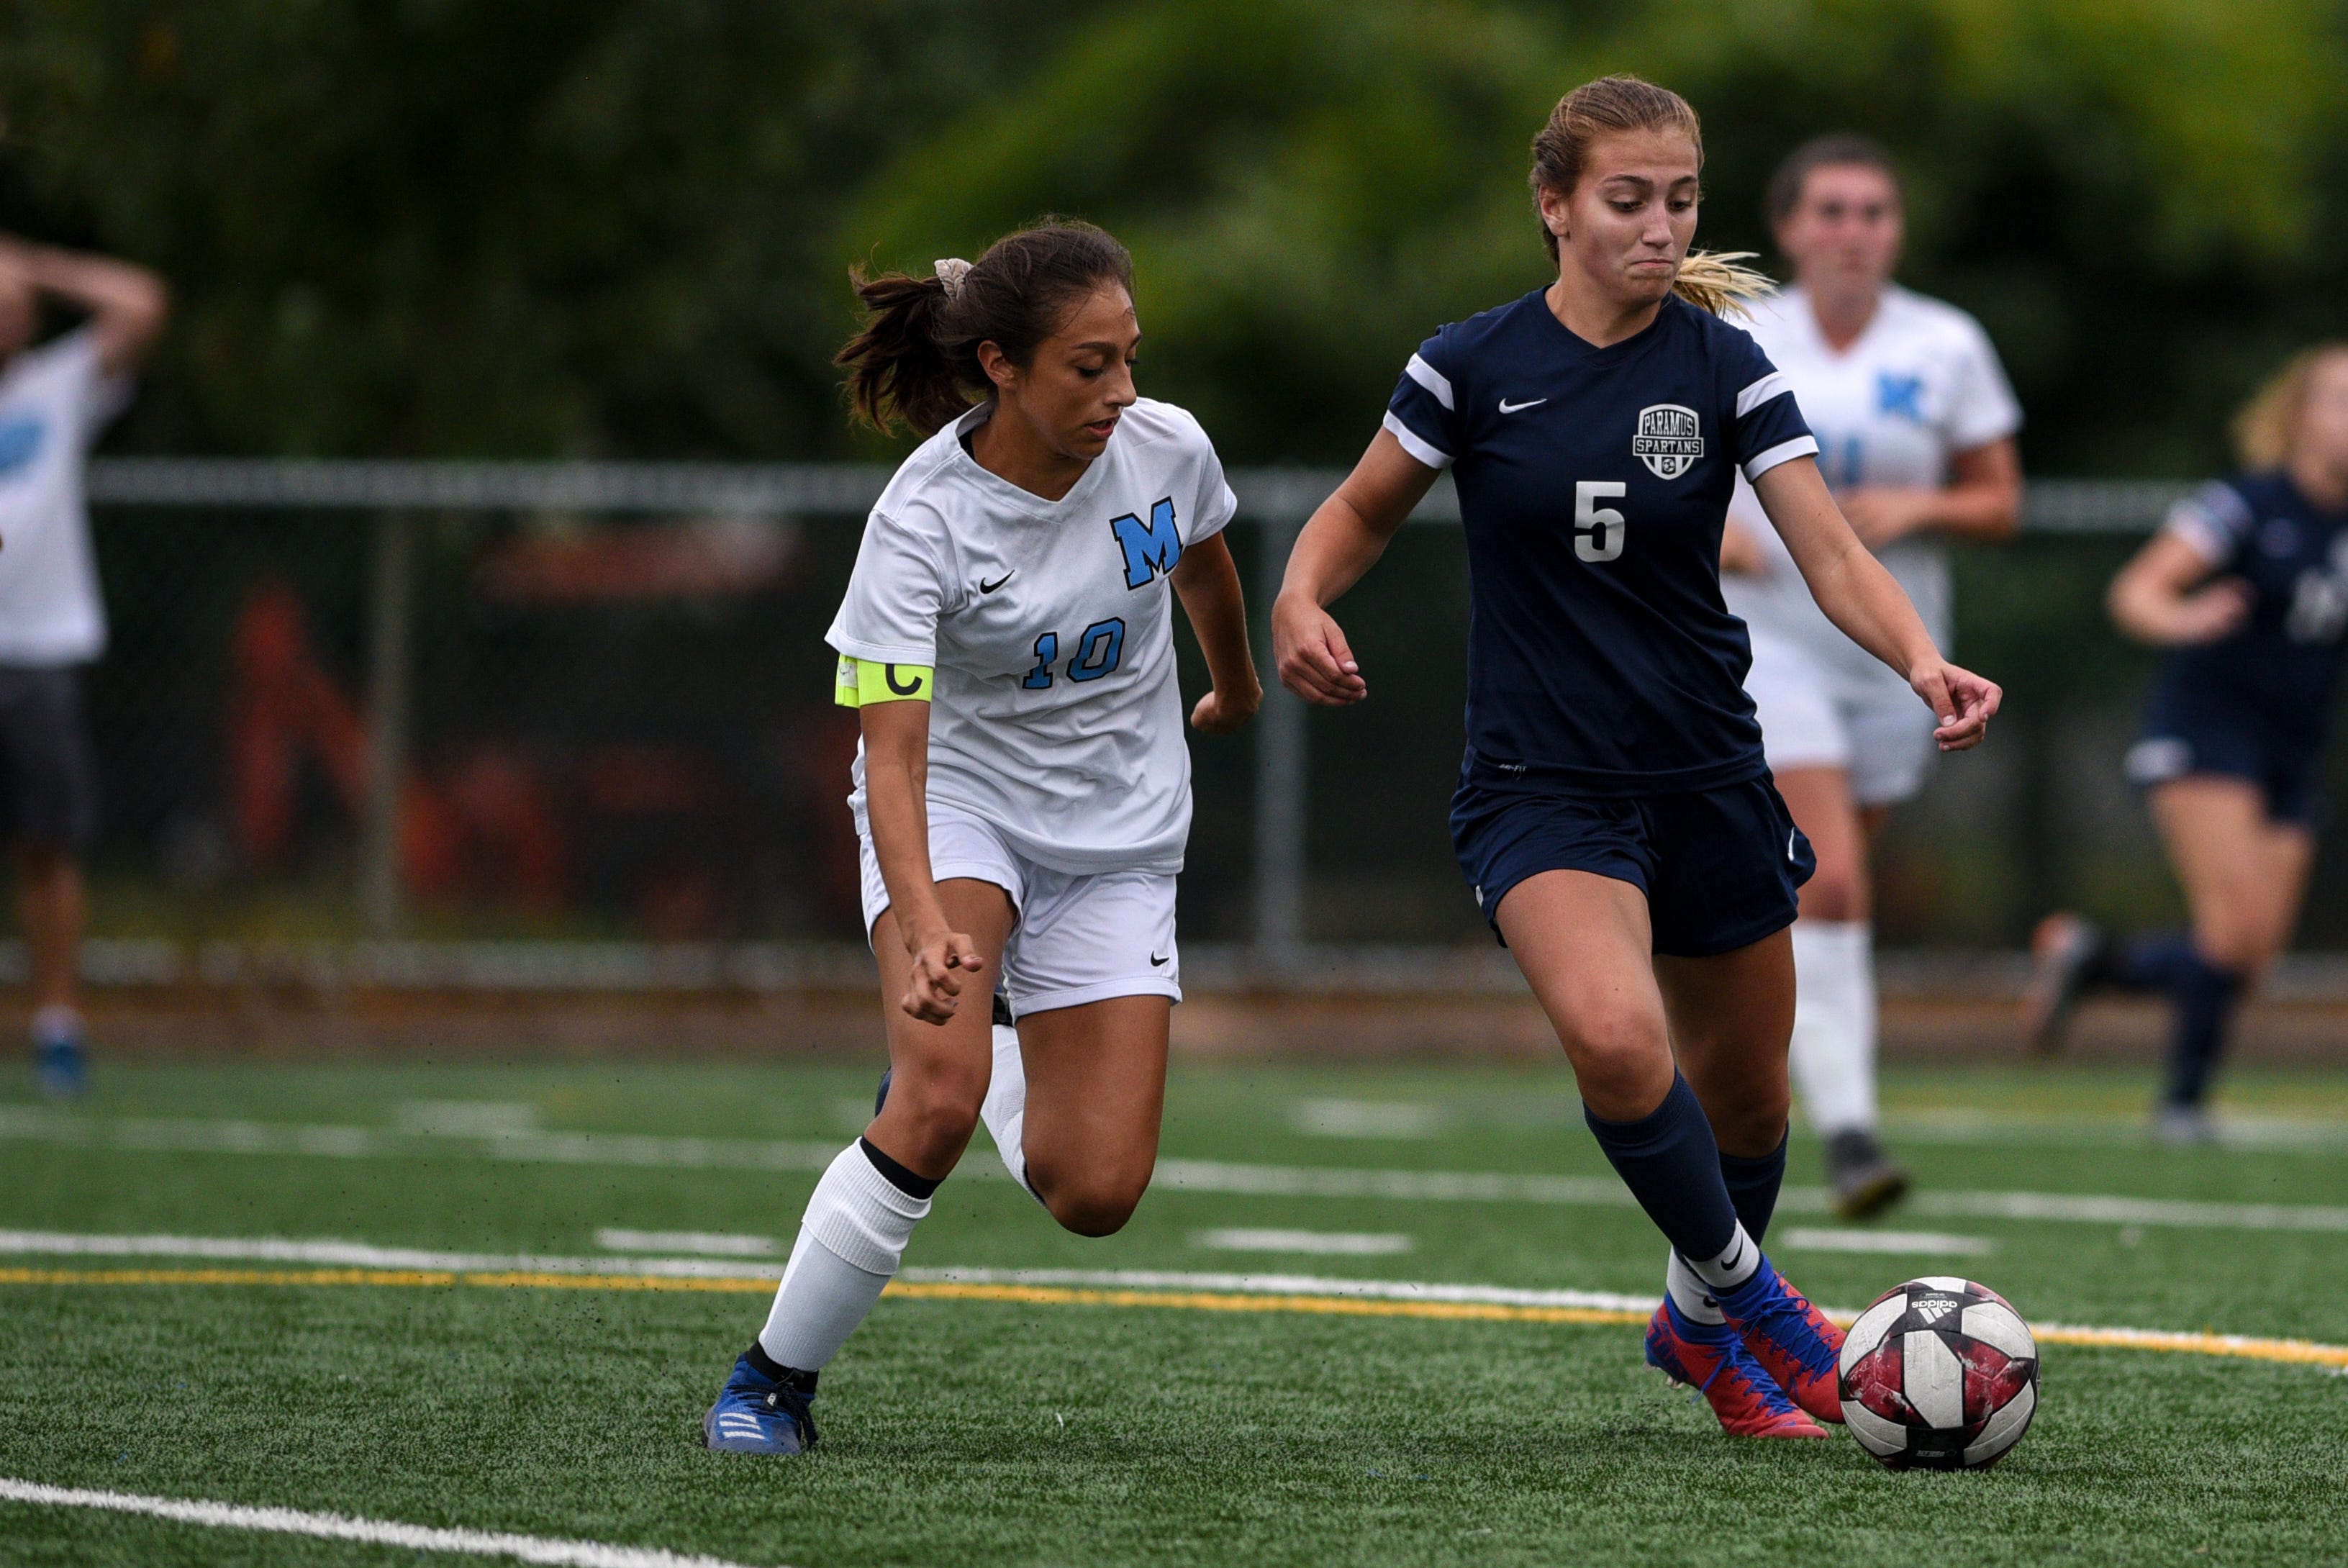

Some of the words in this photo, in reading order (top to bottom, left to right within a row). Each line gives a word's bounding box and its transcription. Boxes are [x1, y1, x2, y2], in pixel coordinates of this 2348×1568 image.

[1636, 439, 1700, 453] SPARTANS
[1644, 411, 1693, 436] PARAMUS
[1109, 496, 1184, 591] M
[1574, 481, 1626, 563] 5
[1022, 617, 1125, 689] 10
[1911, 1300, 1958, 1309] adidas
